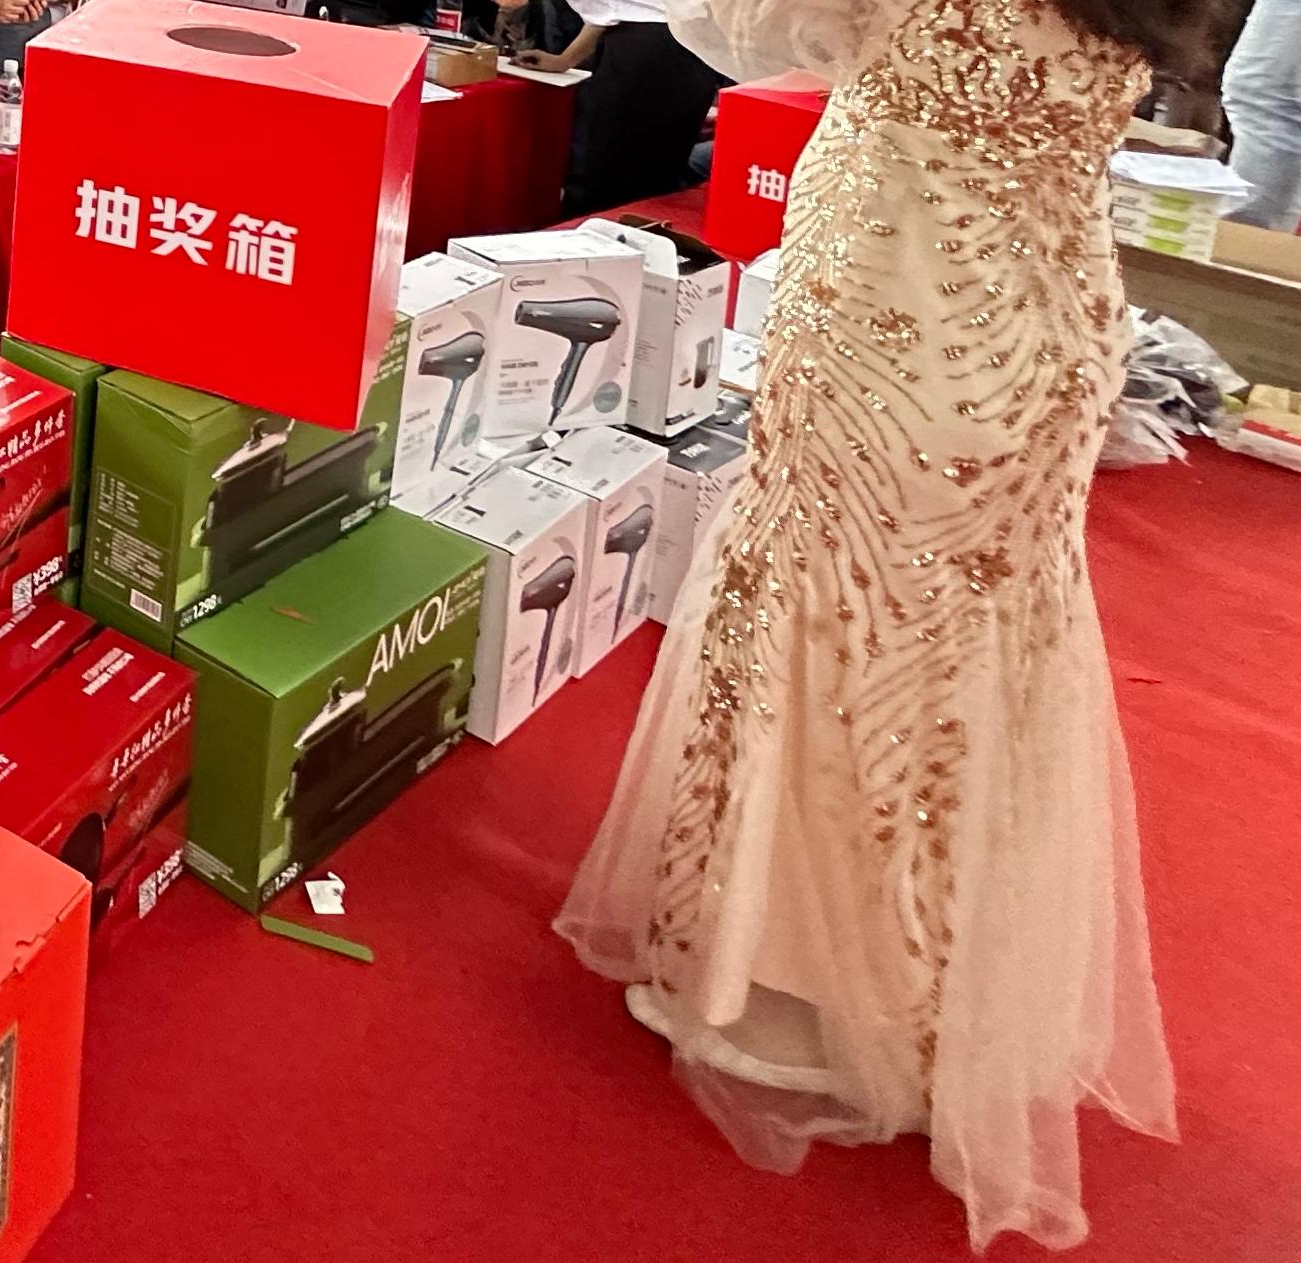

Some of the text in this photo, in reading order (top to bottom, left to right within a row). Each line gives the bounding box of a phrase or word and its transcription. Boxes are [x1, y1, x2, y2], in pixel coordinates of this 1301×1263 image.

[74, 178, 299, 286] 抽奖箱
[747, 164, 786, 203] 抽
[365, 587, 451, 687] AMOI
